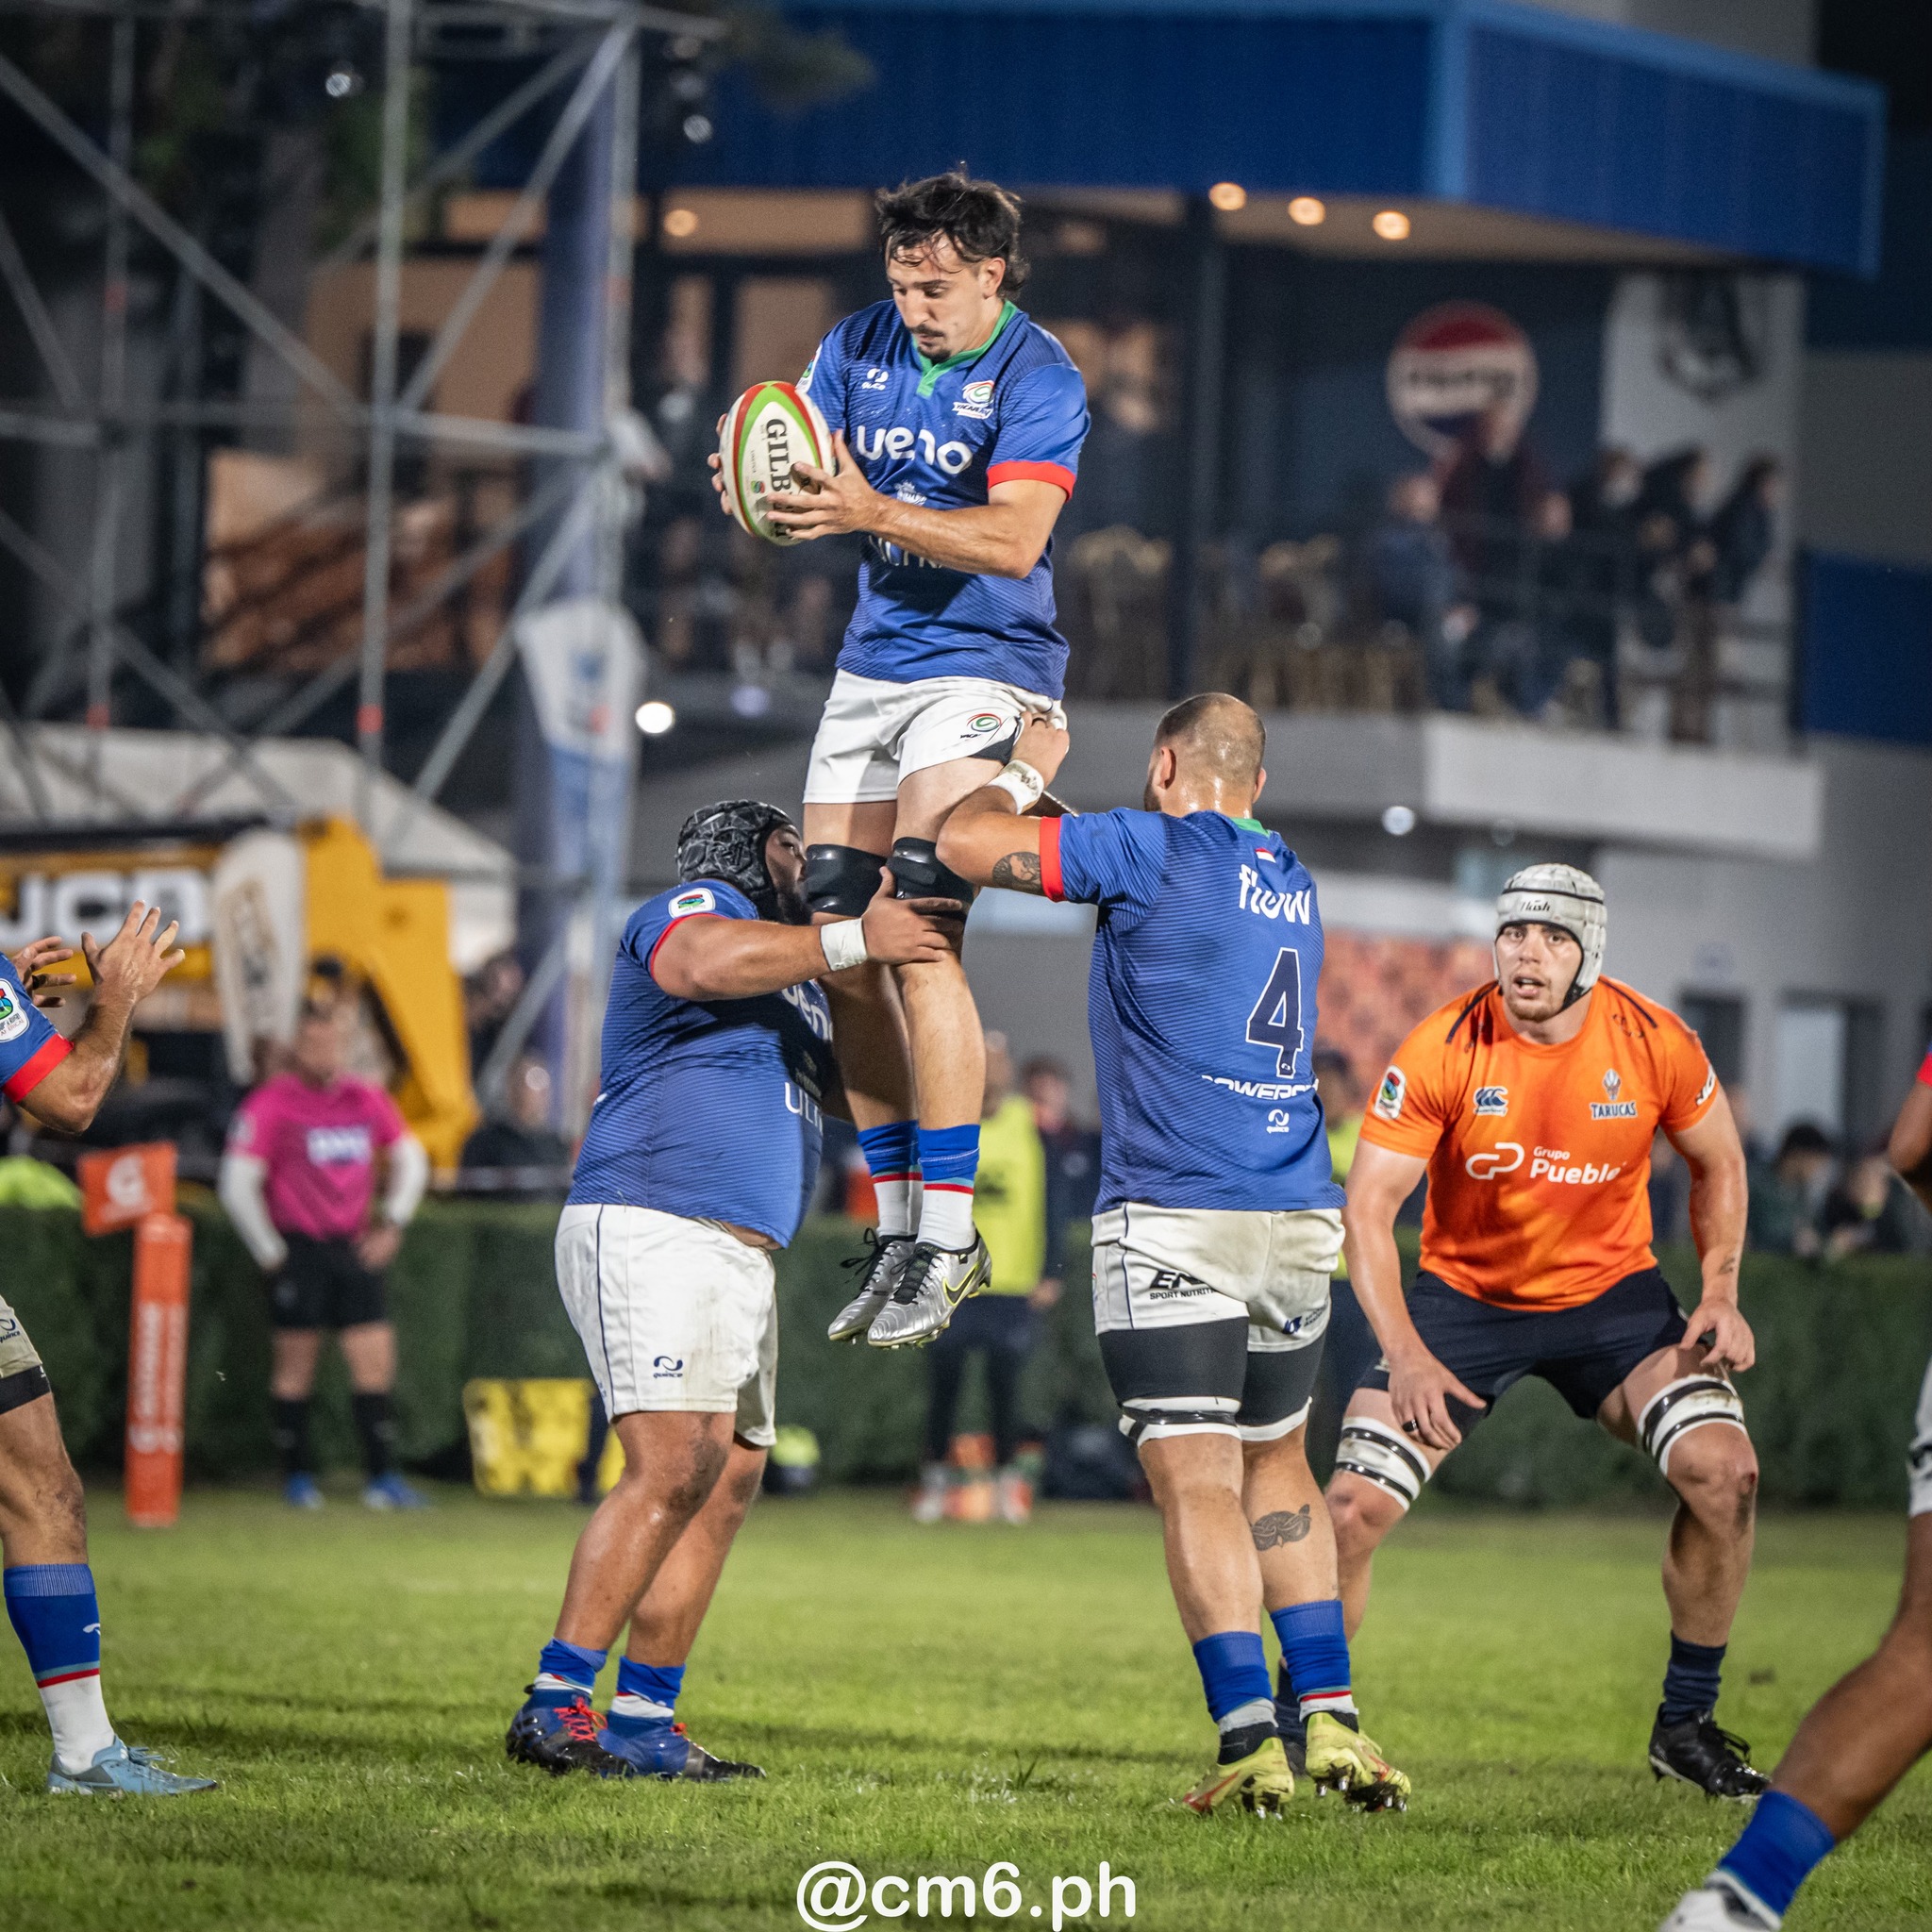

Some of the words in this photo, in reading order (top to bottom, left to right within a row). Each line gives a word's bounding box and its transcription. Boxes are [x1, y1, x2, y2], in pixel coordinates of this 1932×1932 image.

[857, 425, 974, 475] ueno
[781, 985, 833, 1042] uen
[1245, 947, 1304, 1079] 4
[1591, 1102, 1637, 1118] TARUCAS
[1533, 1145, 1571, 1161] Grupo
[1149, 1291, 1178, 1300] SPORT
